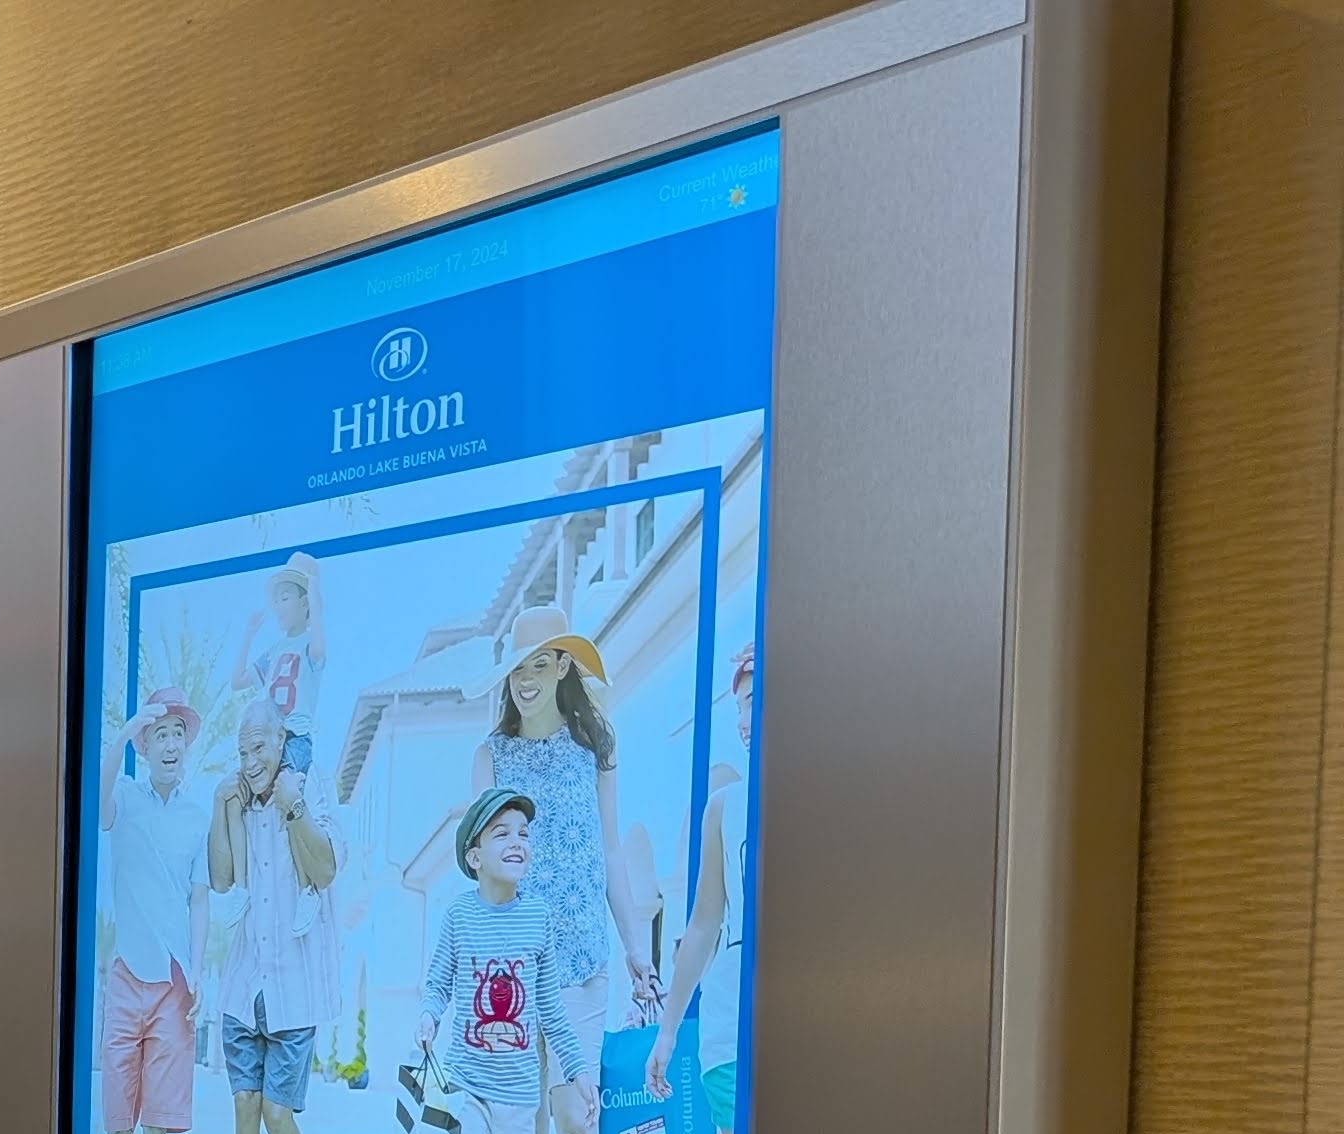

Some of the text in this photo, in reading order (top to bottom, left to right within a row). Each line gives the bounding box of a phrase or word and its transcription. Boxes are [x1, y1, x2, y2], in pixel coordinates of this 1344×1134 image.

[366, 239, 508, 296] November 17, 2024
[331, 391, 465, 454] Hilton
[308, 439, 487, 489] ORLANDO LAKE BUENA VISTA
